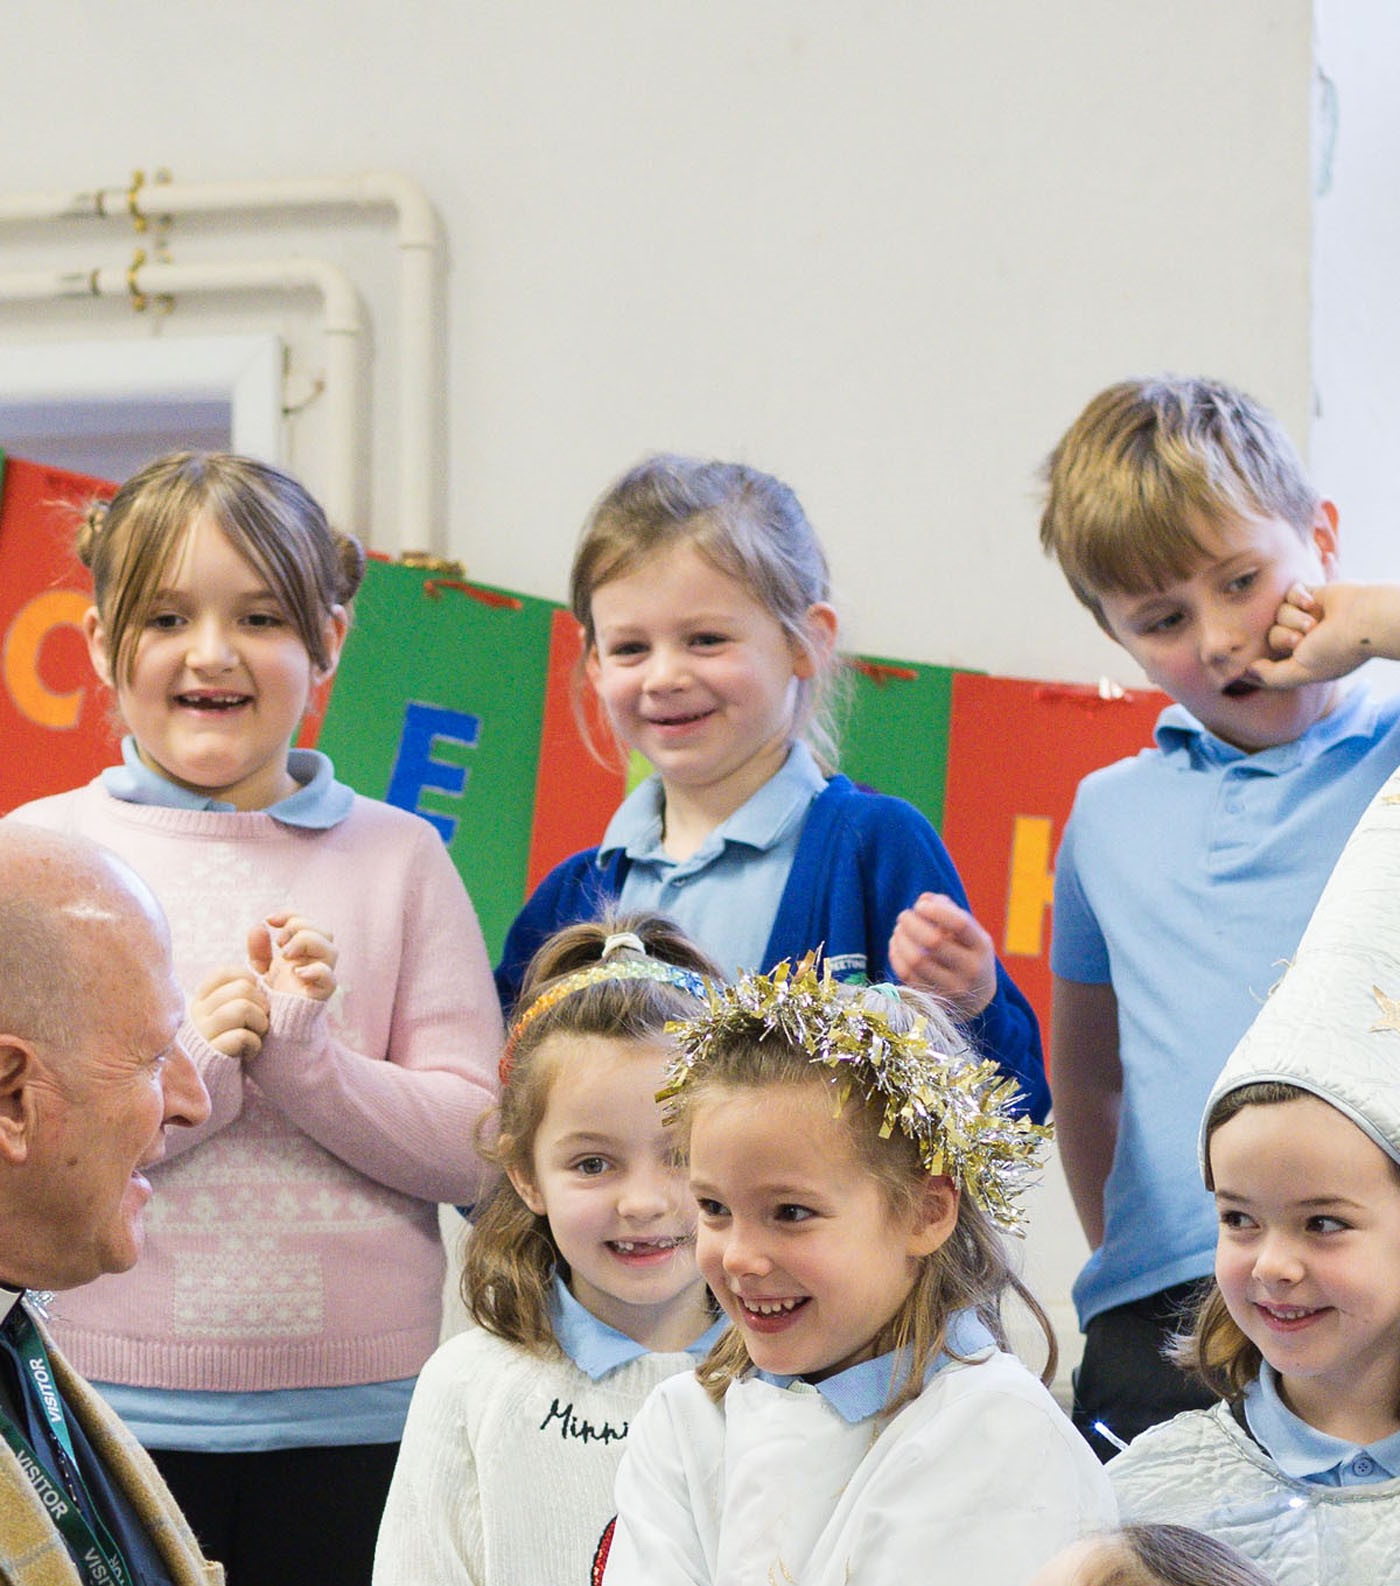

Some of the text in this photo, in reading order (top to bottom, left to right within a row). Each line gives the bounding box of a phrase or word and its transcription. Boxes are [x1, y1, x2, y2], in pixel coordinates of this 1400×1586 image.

[2, 588, 95, 730] C
[385, 699, 482, 848] E
[29, 1358, 62, 1422] VISITOR
[540, 1398, 629, 1446] Minni
[16, 1450, 69, 1520] VISITOR
